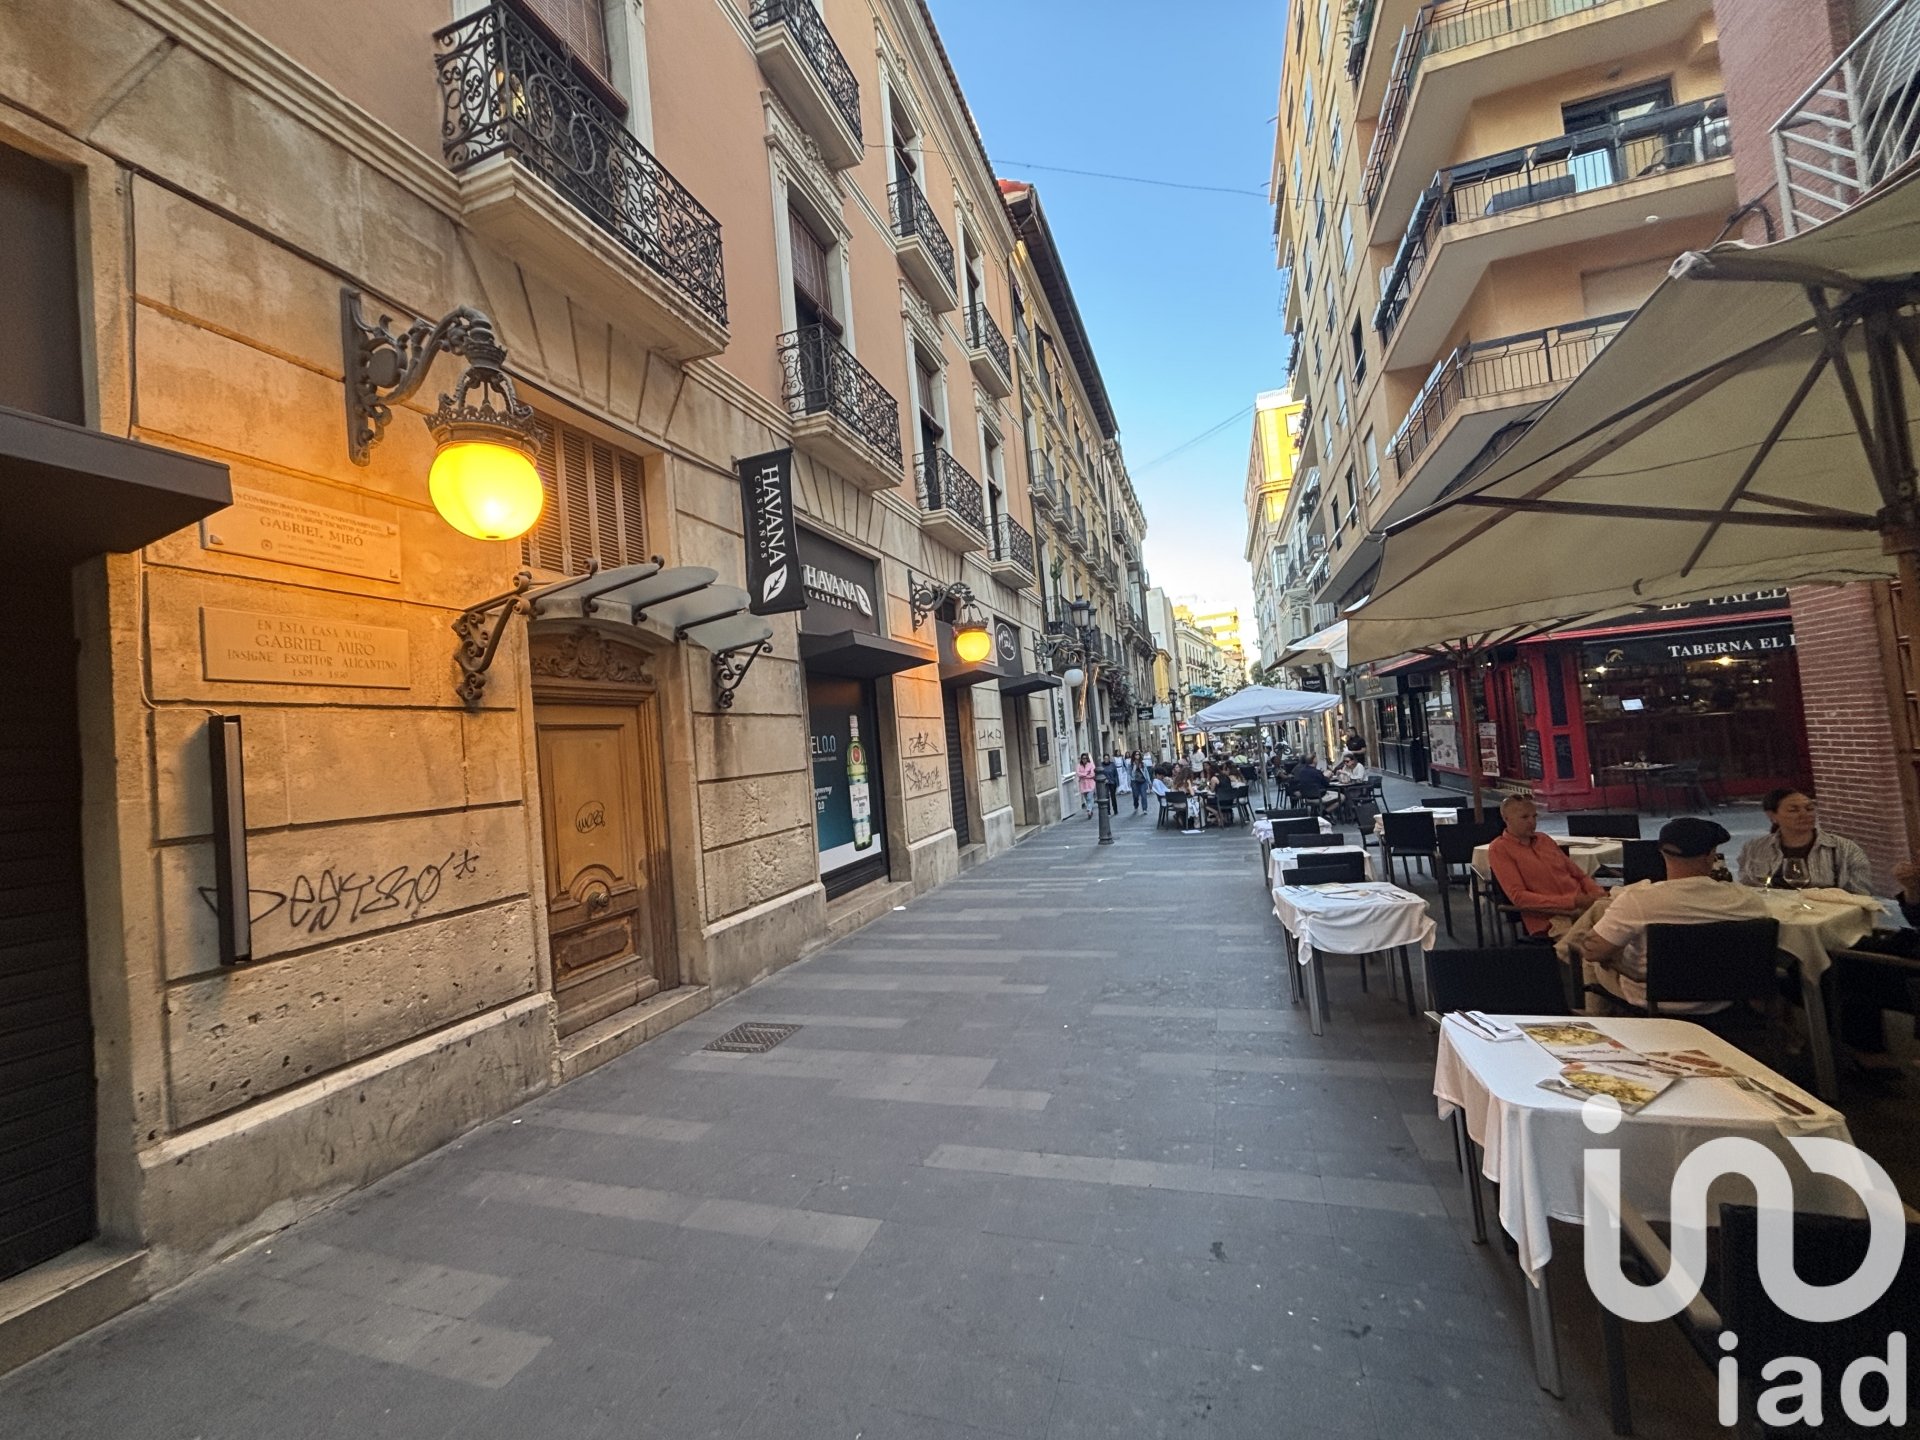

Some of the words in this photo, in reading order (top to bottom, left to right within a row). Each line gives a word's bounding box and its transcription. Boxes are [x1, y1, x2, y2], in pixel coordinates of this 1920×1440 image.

[762, 464, 786, 567] HAVANA
[259, 516, 324, 539] GABRIEL
[329, 530, 364, 547] MIRÓ
[801, 564, 858, 603] HAVANA
[257, 619, 272, 631] EN
[280, 622, 305, 634] ESTA
[312, 625, 339, 638] CASA
[255, 634, 323, 652] GABRIEL
[1668, 640, 1753, 657] TABERNA
[1759, 637, 1784, 649] EL
[227, 649, 274, 663] INSIGNE
[284, 653, 333, 667] ESCRITOR
[342, 657, 397, 671] ALICANTINO
